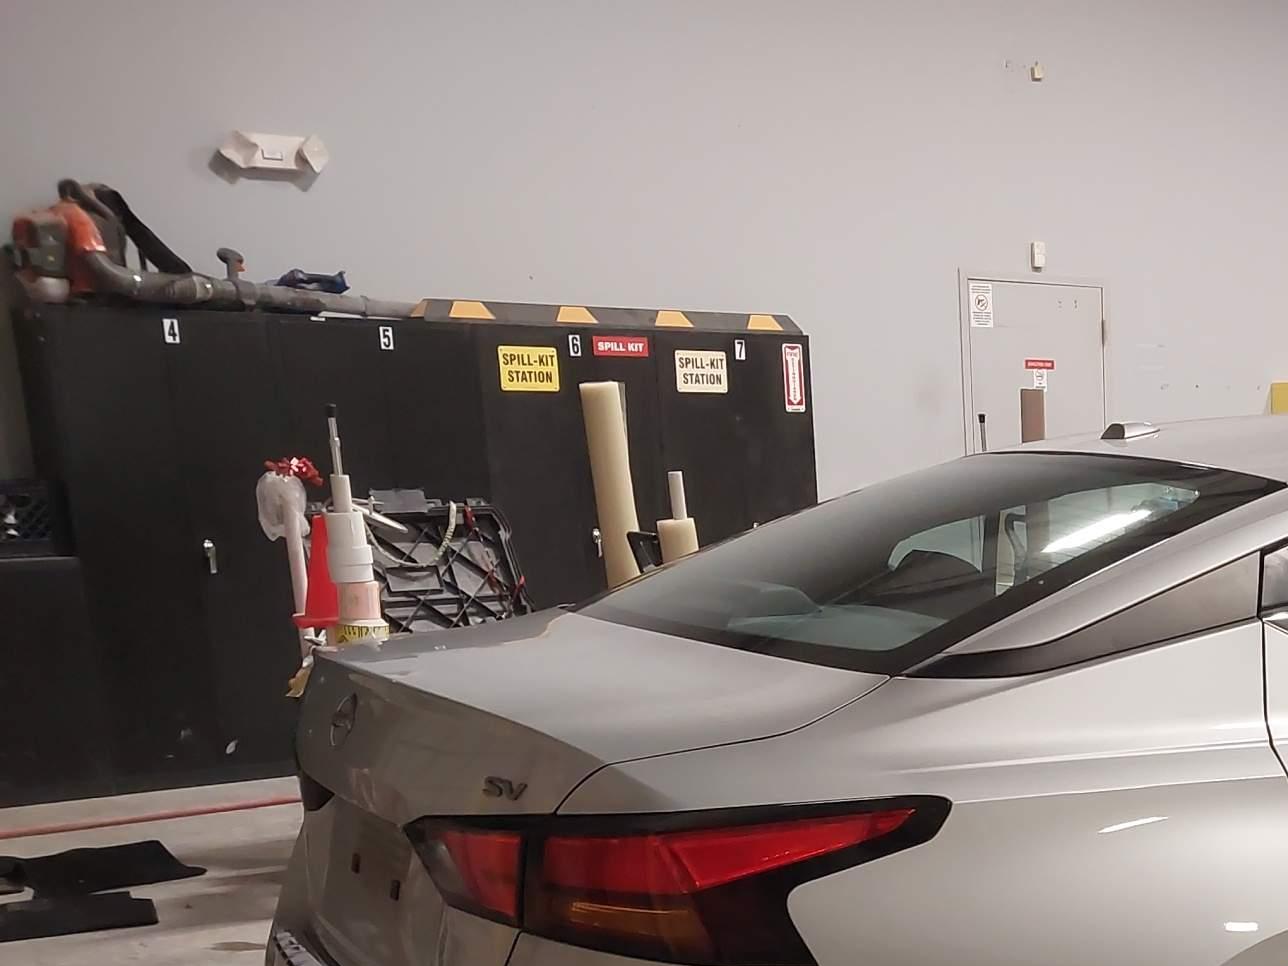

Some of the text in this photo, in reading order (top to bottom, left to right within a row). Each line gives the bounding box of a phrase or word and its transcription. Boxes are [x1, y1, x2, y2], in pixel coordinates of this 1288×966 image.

[168, 320, 177, 341] 4
[382, 328, 391, 348] 5
[571, 336, 579, 354] 6
[597, 341, 644, 352] SPILL KIT
[736, 341, 743, 358] 7
[502, 353, 554, 366] SPILL-KIT
[678, 357, 724, 369] SPILL-KIT
[507, 370, 552, 383] STATION
[683, 373, 722, 385] STATION
[482, 776, 528, 801] SV
